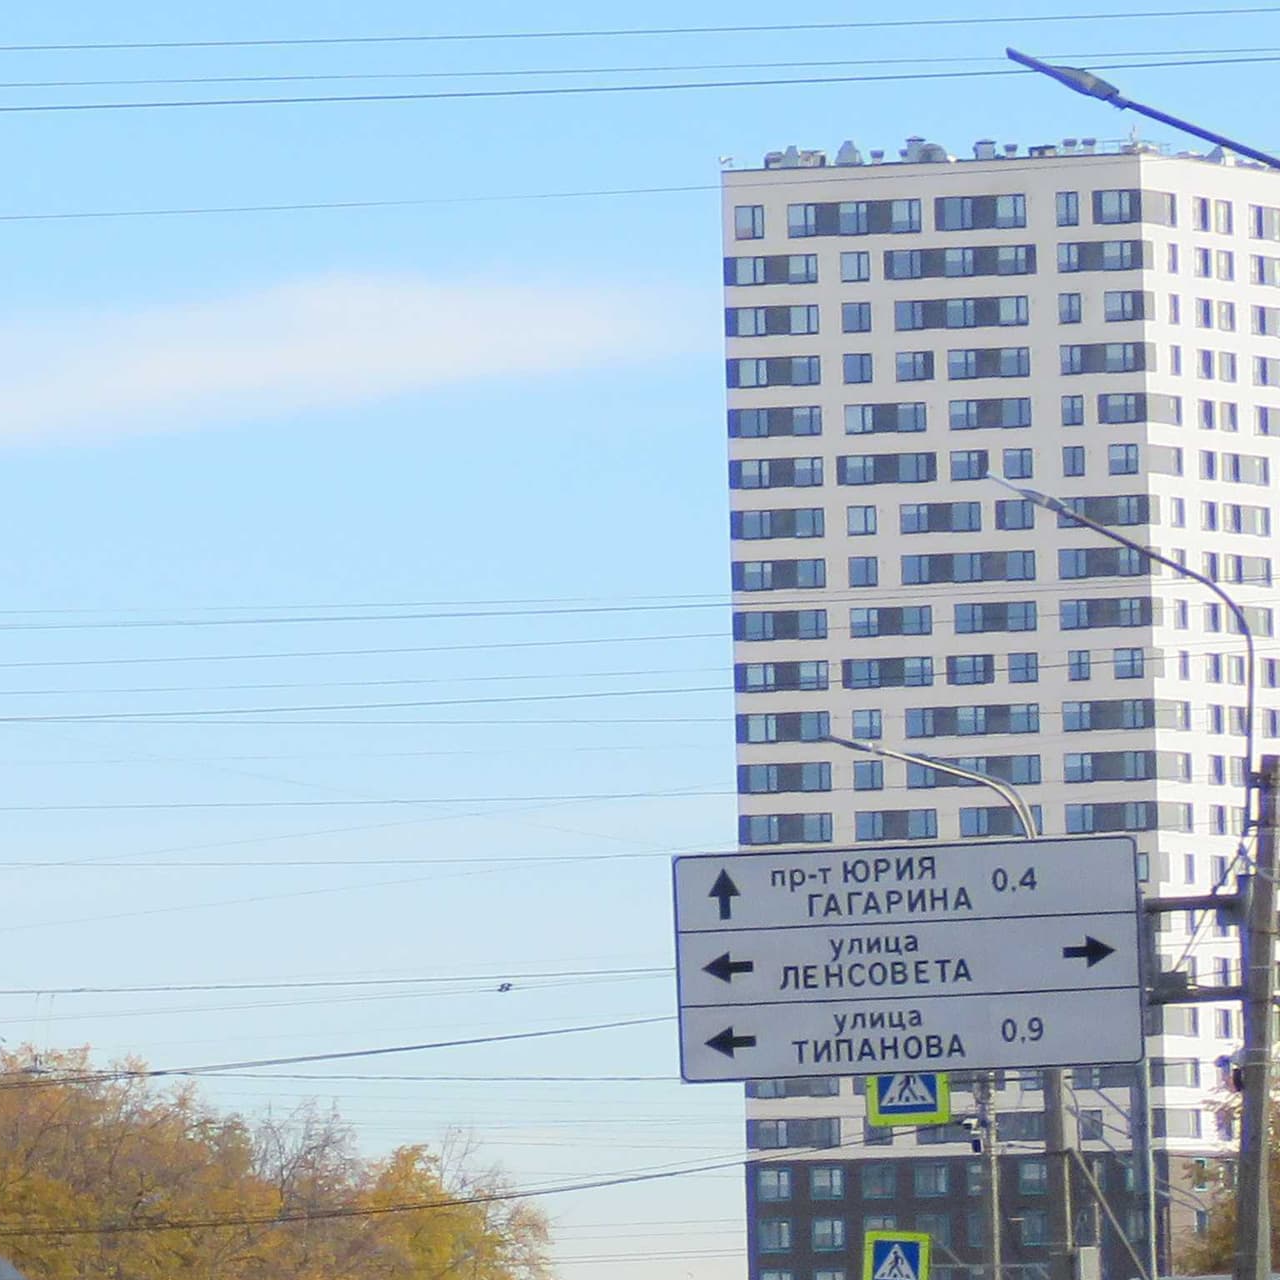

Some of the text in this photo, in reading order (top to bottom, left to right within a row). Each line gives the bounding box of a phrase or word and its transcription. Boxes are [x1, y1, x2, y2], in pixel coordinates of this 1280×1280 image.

[770, 855, 937, 892] пр-т ЮРИЯ
[807, 886, 973, 918] ГАГАРИНА
[829, 934, 919, 961] улица
[779, 958, 973, 991] ЛЕНСОВЕТА
[834, 1009, 923, 1036] улица
[792, 1033, 966, 1065] ТИПАНОВА
